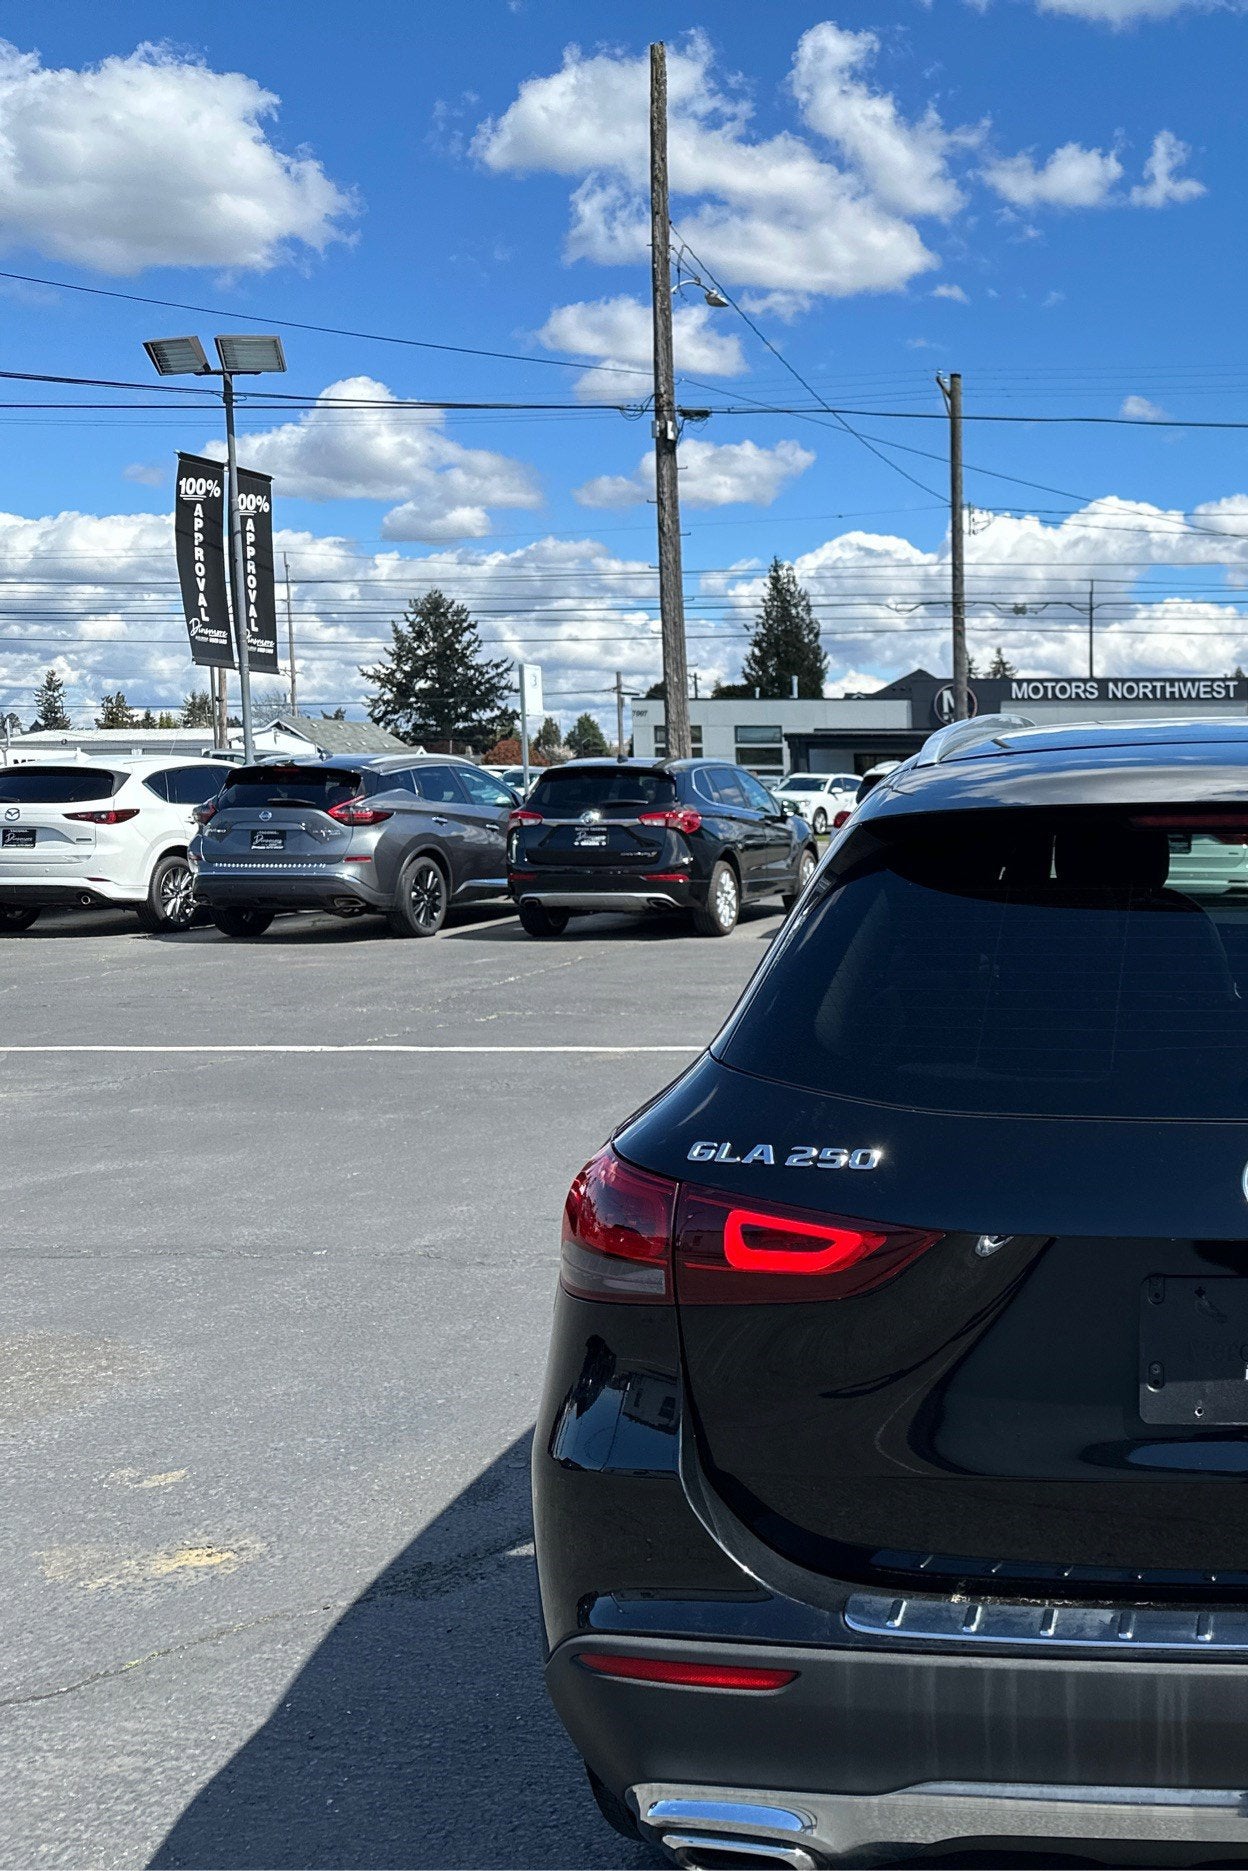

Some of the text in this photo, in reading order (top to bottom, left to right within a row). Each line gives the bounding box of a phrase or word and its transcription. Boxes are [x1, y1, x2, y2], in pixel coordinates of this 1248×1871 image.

[179, 477, 221, 498] 100%
[238, 493, 270, 513] 00%
[193, 503, 209, 622] APPROVAL
[245, 518, 259, 632] APPROVAL
[1011, 681, 1238, 700] MOTORS NORTHWEST
[686, 1141, 882, 1170] GLA 250
